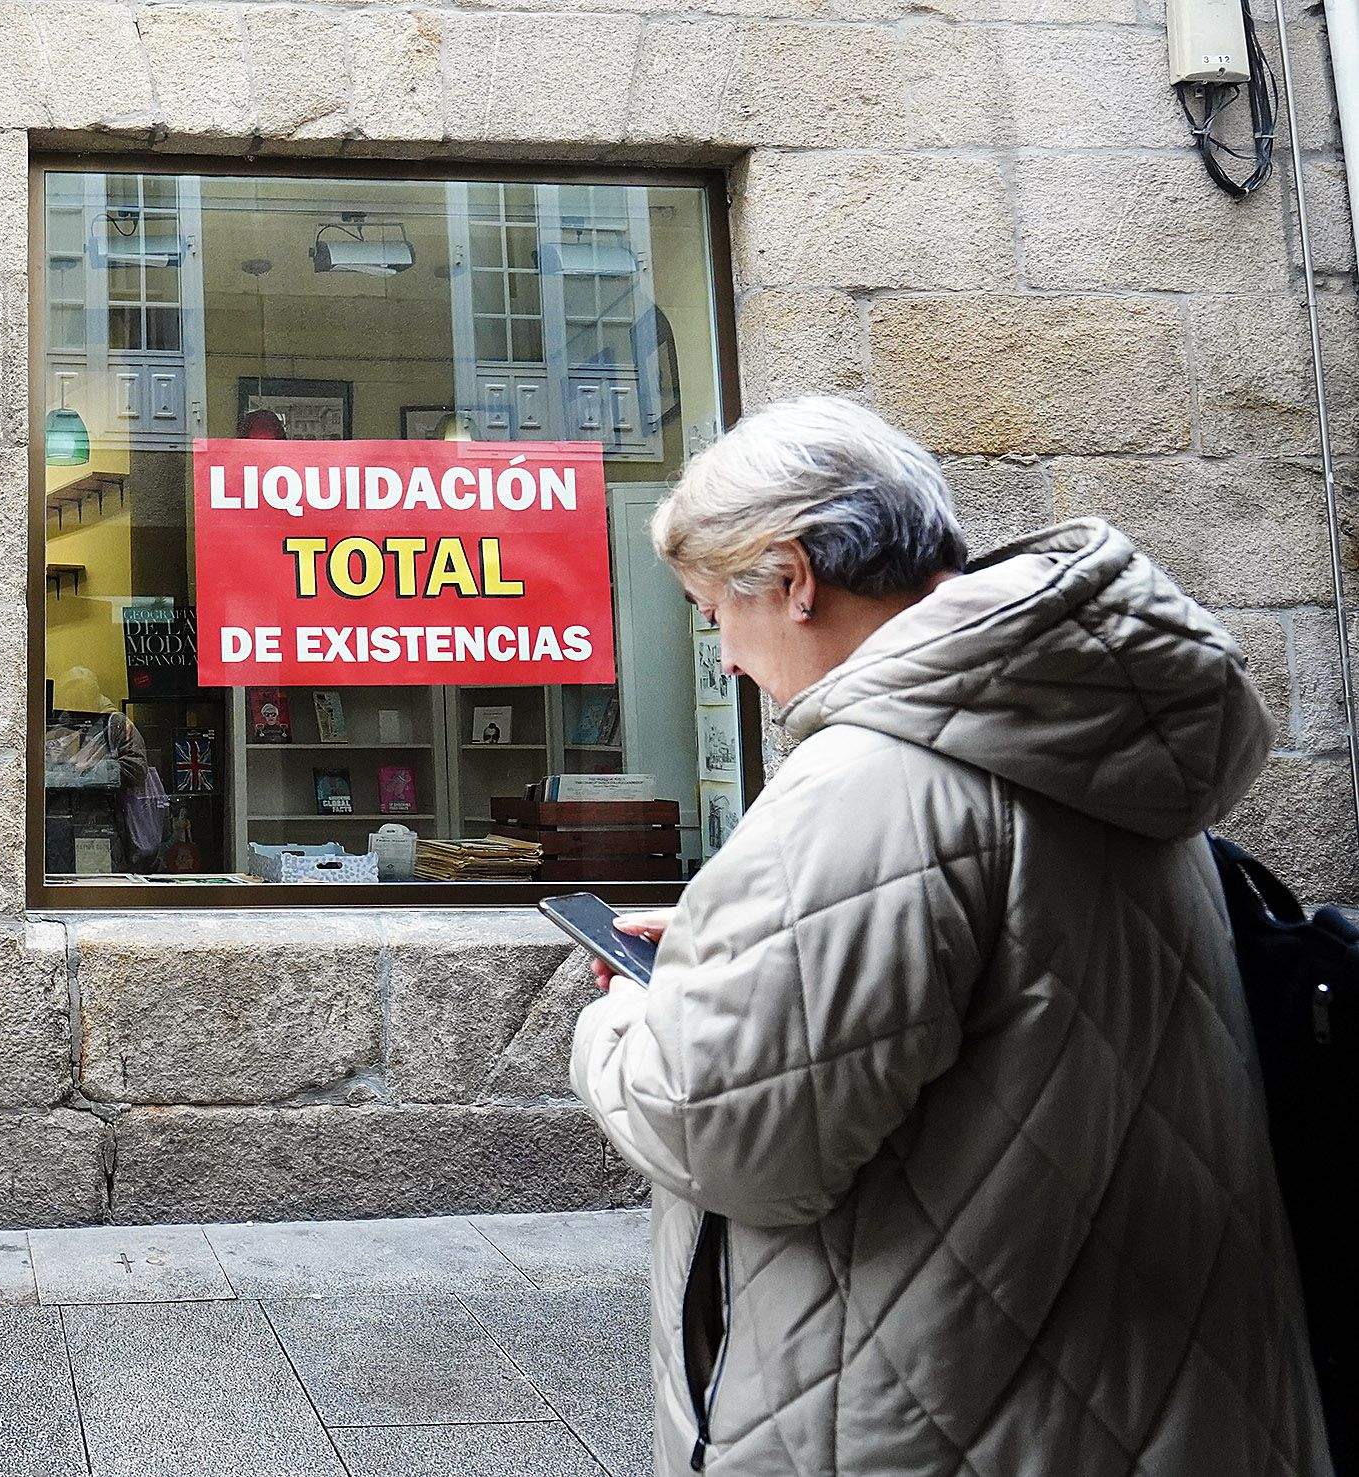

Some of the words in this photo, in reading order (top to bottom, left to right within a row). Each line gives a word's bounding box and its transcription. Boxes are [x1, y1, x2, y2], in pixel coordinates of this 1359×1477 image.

[209, 453, 578, 517] LIQUIDACIÓN
[283, 536, 525, 598] TOTAL
[125, 619, 159, 635] DE
[166, 618, 197, 635] LA
[126, 634, 198, 654] MODA
[220, 626, 283, 663] DE
[296, 625, 593, 662] EXISTENCIAS
